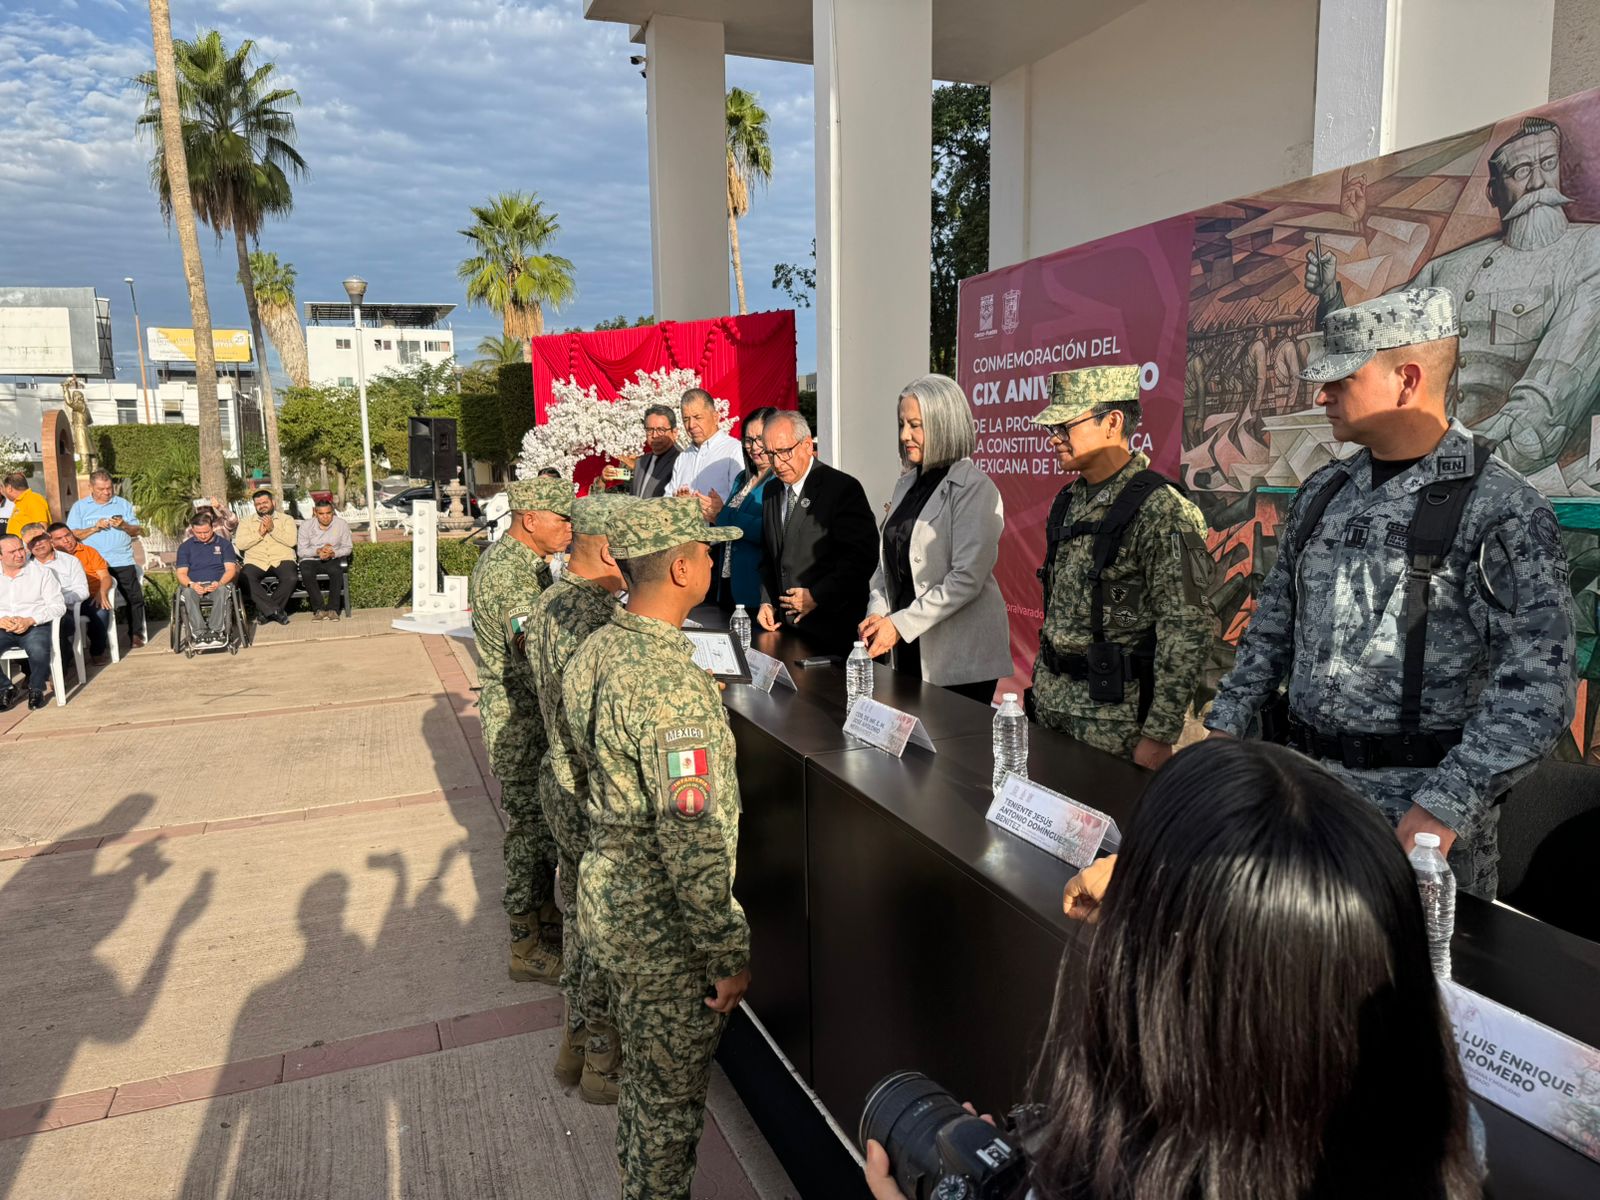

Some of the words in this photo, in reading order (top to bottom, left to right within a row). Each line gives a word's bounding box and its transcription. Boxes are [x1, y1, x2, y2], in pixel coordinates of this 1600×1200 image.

[973, 339, 1087, 374] CONMEMORACIÓN
[1091, 336, 1121, 357] DEL
[972, 381, 1001, 406] CIX
[989, 417, 1003, 433] LA
[1032, 458, 1050, 474] DE
[666, 726, 704, 742] MEXICO
[999, 805, 1027, 825] ANTONIO
[1004, 797, 1033, 819] TENIENTE
[1031, 811, 1054, 828] JESÚS
[1462, 1030, 1497, 1056] LUIS
[1499, 1049, 1576, 1097] ENRIQUE
[1464, 1048, 1535, 1092] ROMERO
